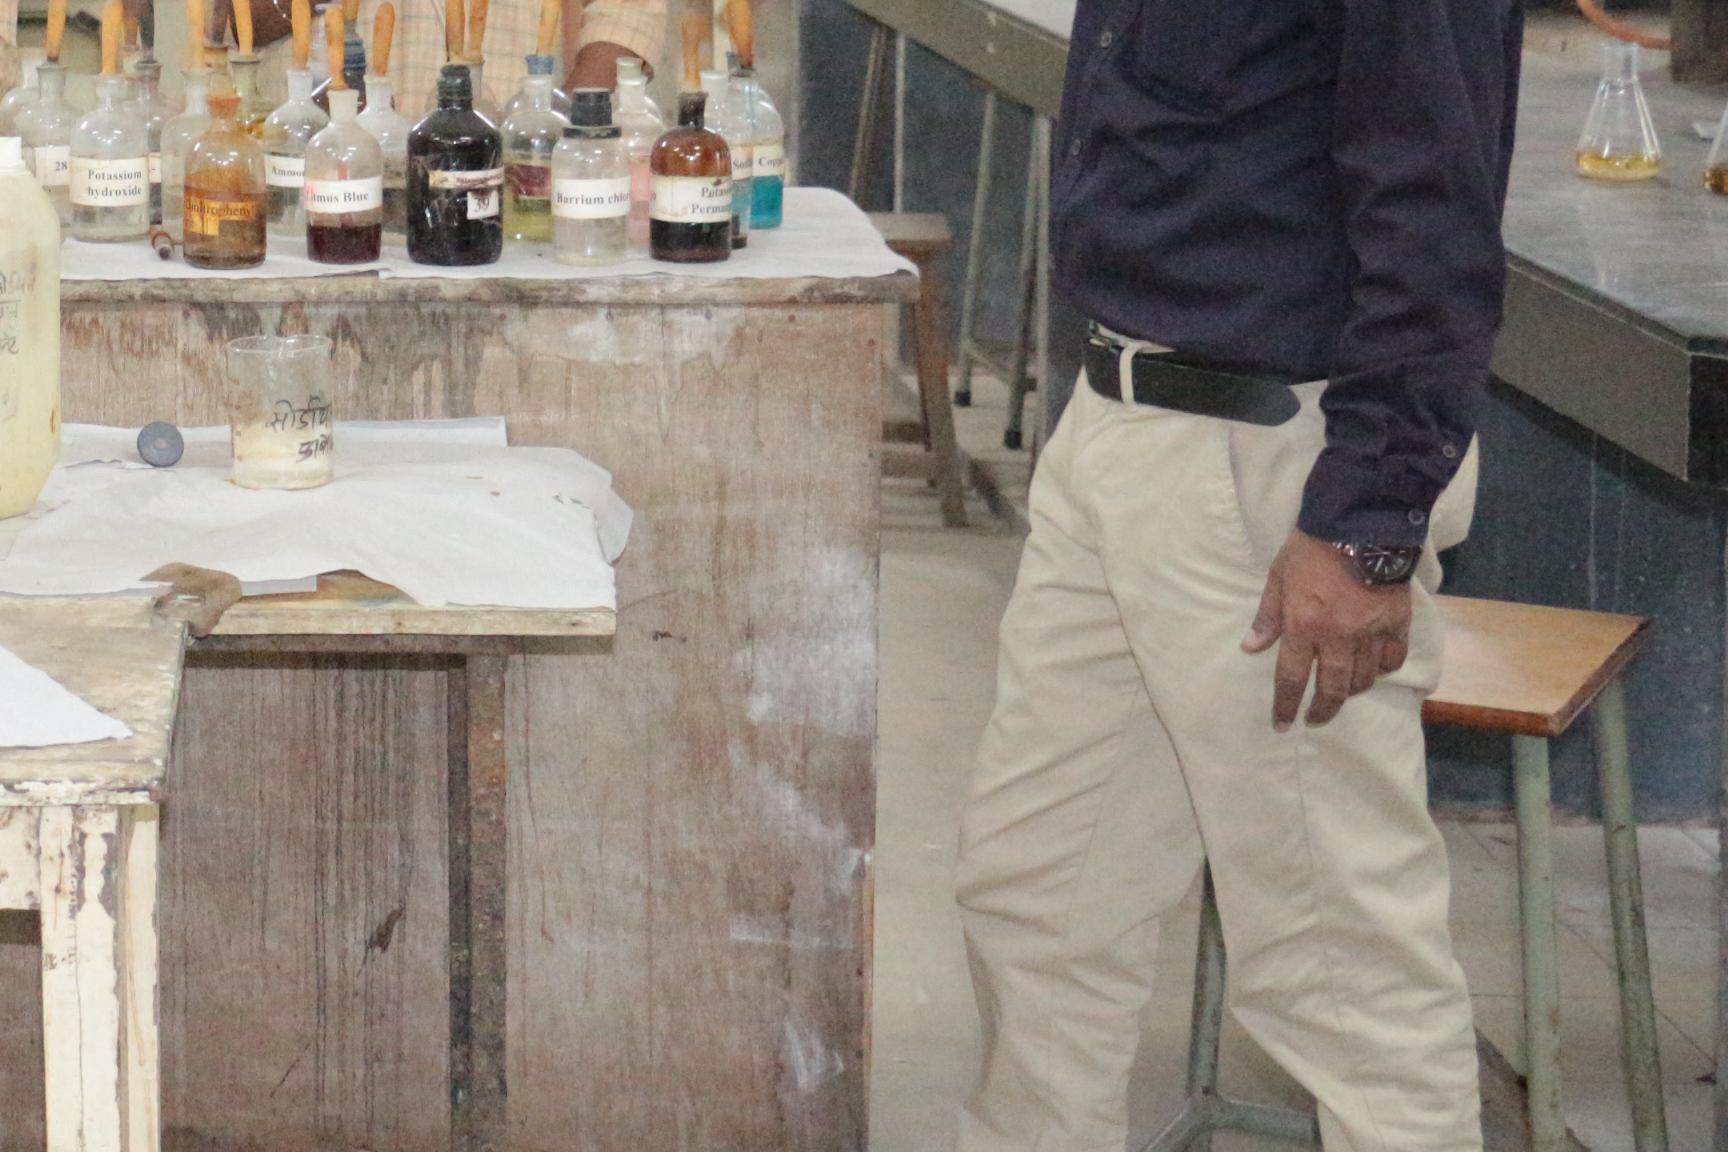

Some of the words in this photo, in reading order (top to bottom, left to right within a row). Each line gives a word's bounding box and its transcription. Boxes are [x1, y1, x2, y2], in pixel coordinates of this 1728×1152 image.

[55, 161, 68, 171] 28
[88, 169, 142, 181] Potassium
[88, 185, 142, 198] hydroxide
[343, 191, 369, 203] Blue
[474, 197, 490, 212] 39
[557, 192, 604, 205] Barrium
